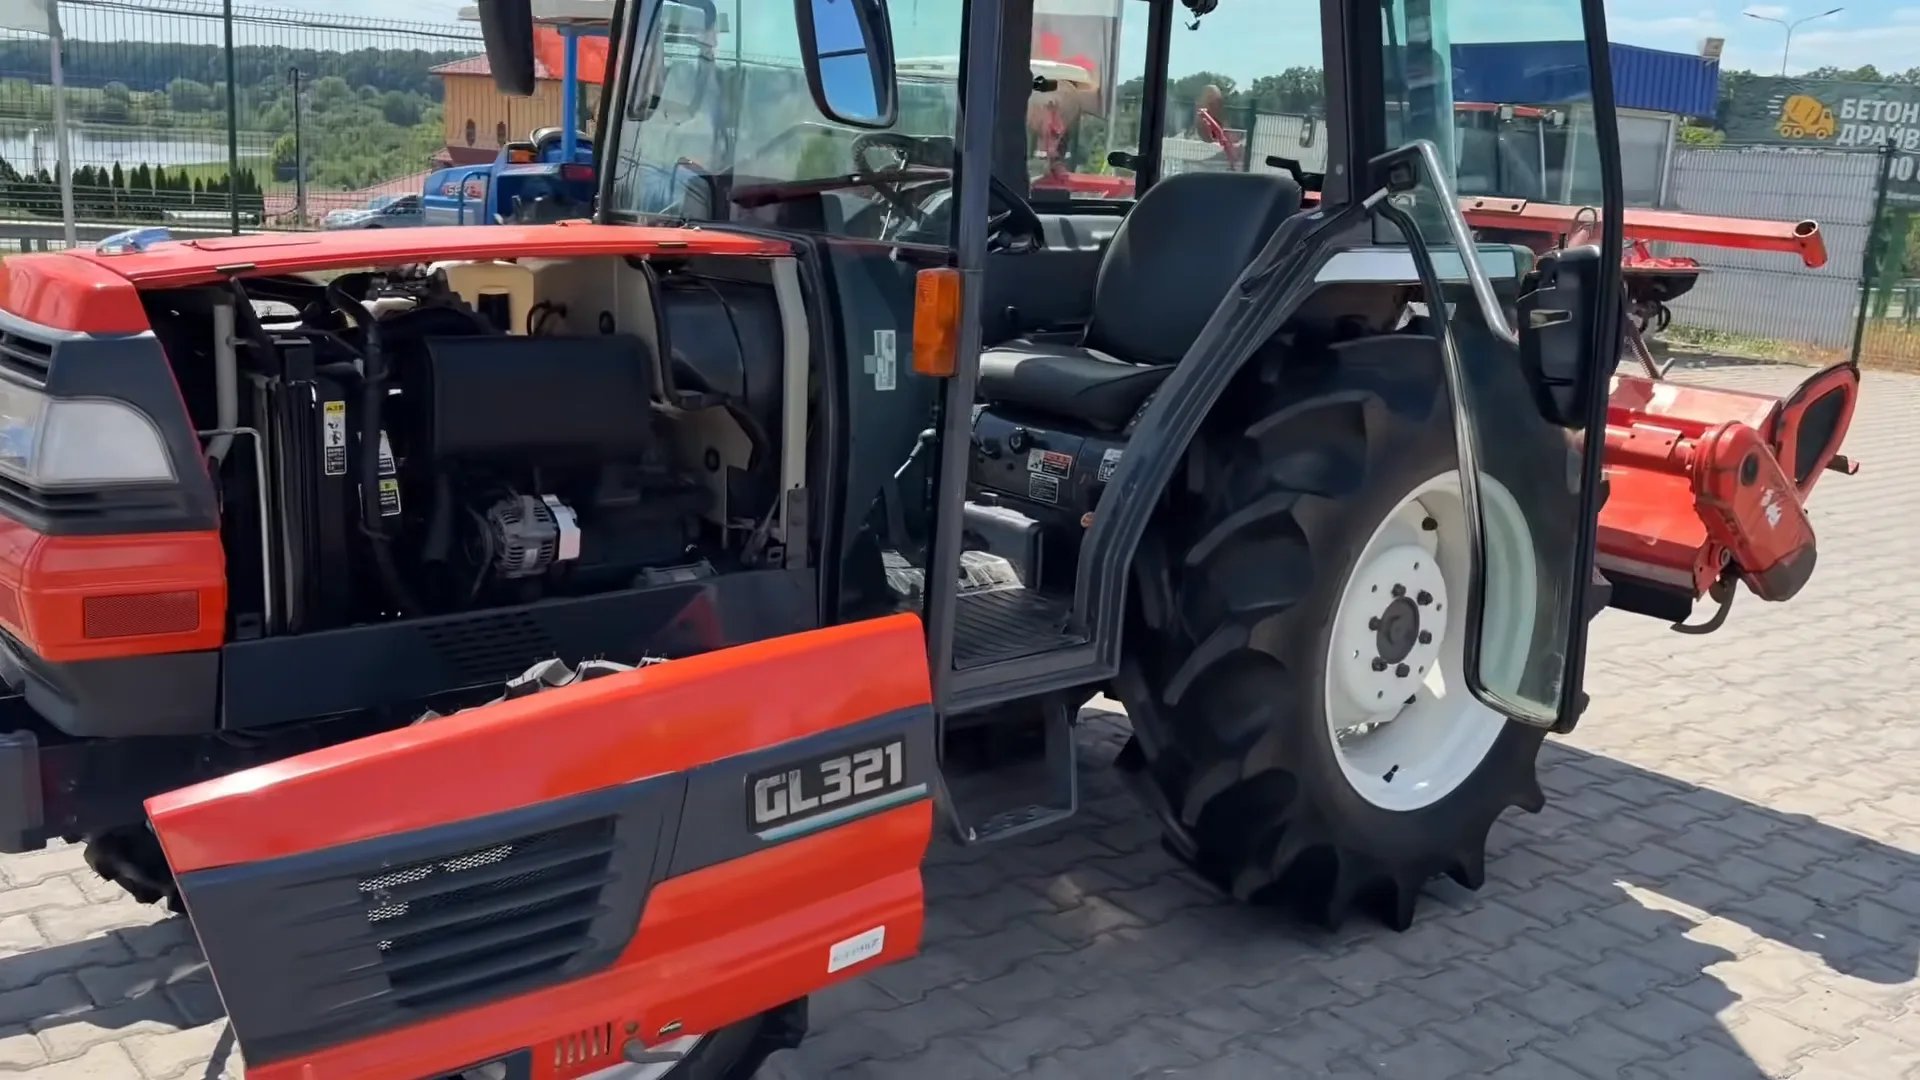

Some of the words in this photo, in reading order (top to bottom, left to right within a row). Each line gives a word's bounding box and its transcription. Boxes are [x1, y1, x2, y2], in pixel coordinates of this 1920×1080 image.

[1840, 99, 1919, 123] БЕТОН
[1836, 123, 1920, 149] ДРАЙВ
[755, 741, 903, 824] GL321
